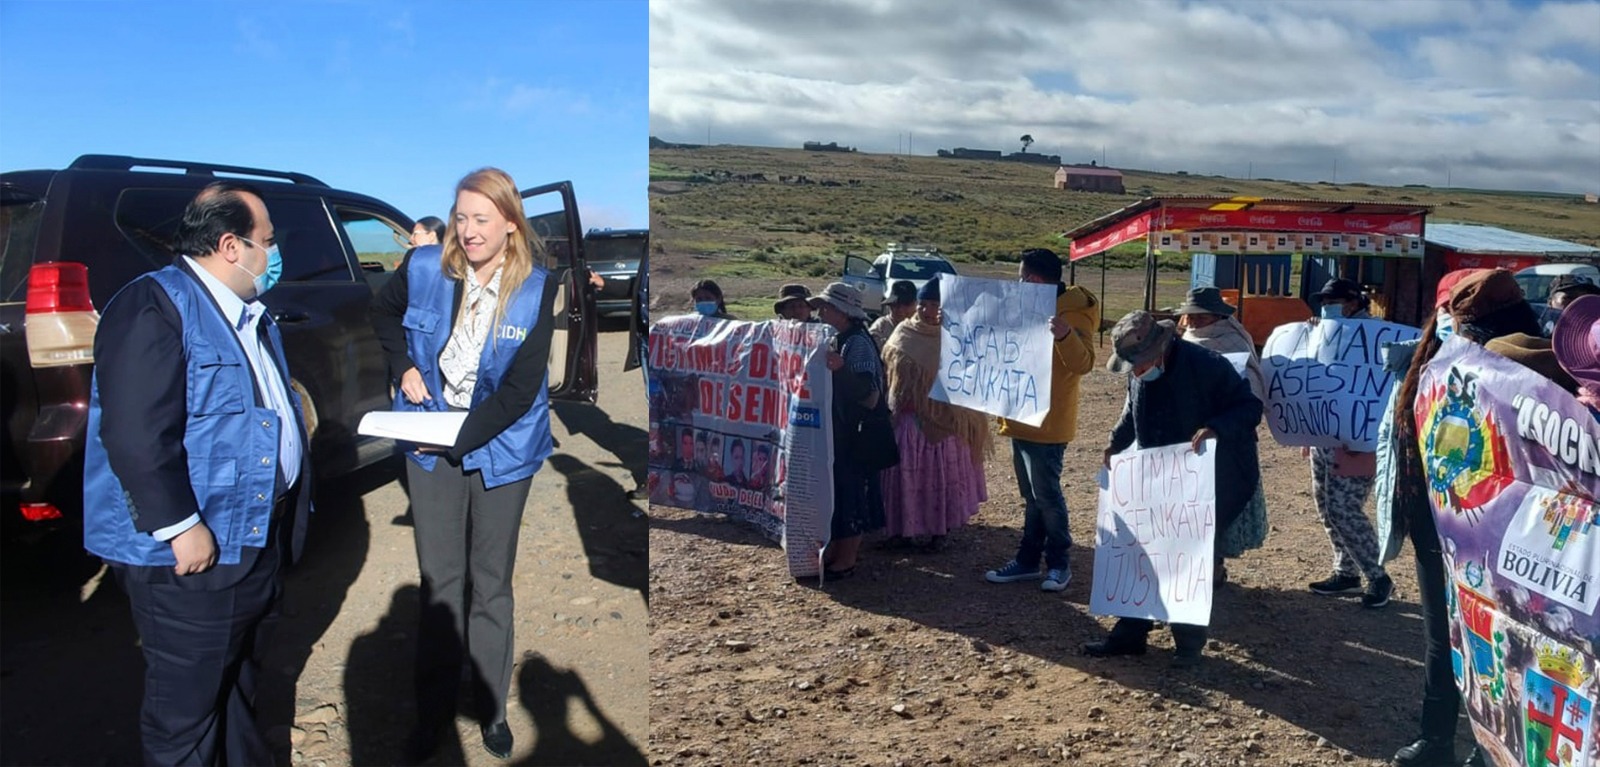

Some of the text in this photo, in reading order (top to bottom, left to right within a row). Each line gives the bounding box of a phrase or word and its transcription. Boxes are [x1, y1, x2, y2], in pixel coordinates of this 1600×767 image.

[701, 379, 723, 417] DE
[947, 360, 1038, 413] SENKATA
[1351, 399, 1380, 442] DE
[1502, 550, 1588, 603] BOLIVIA
[1508, 542, 1532, 558] ESTADO
[1583, 572, 1594, 583] DE
